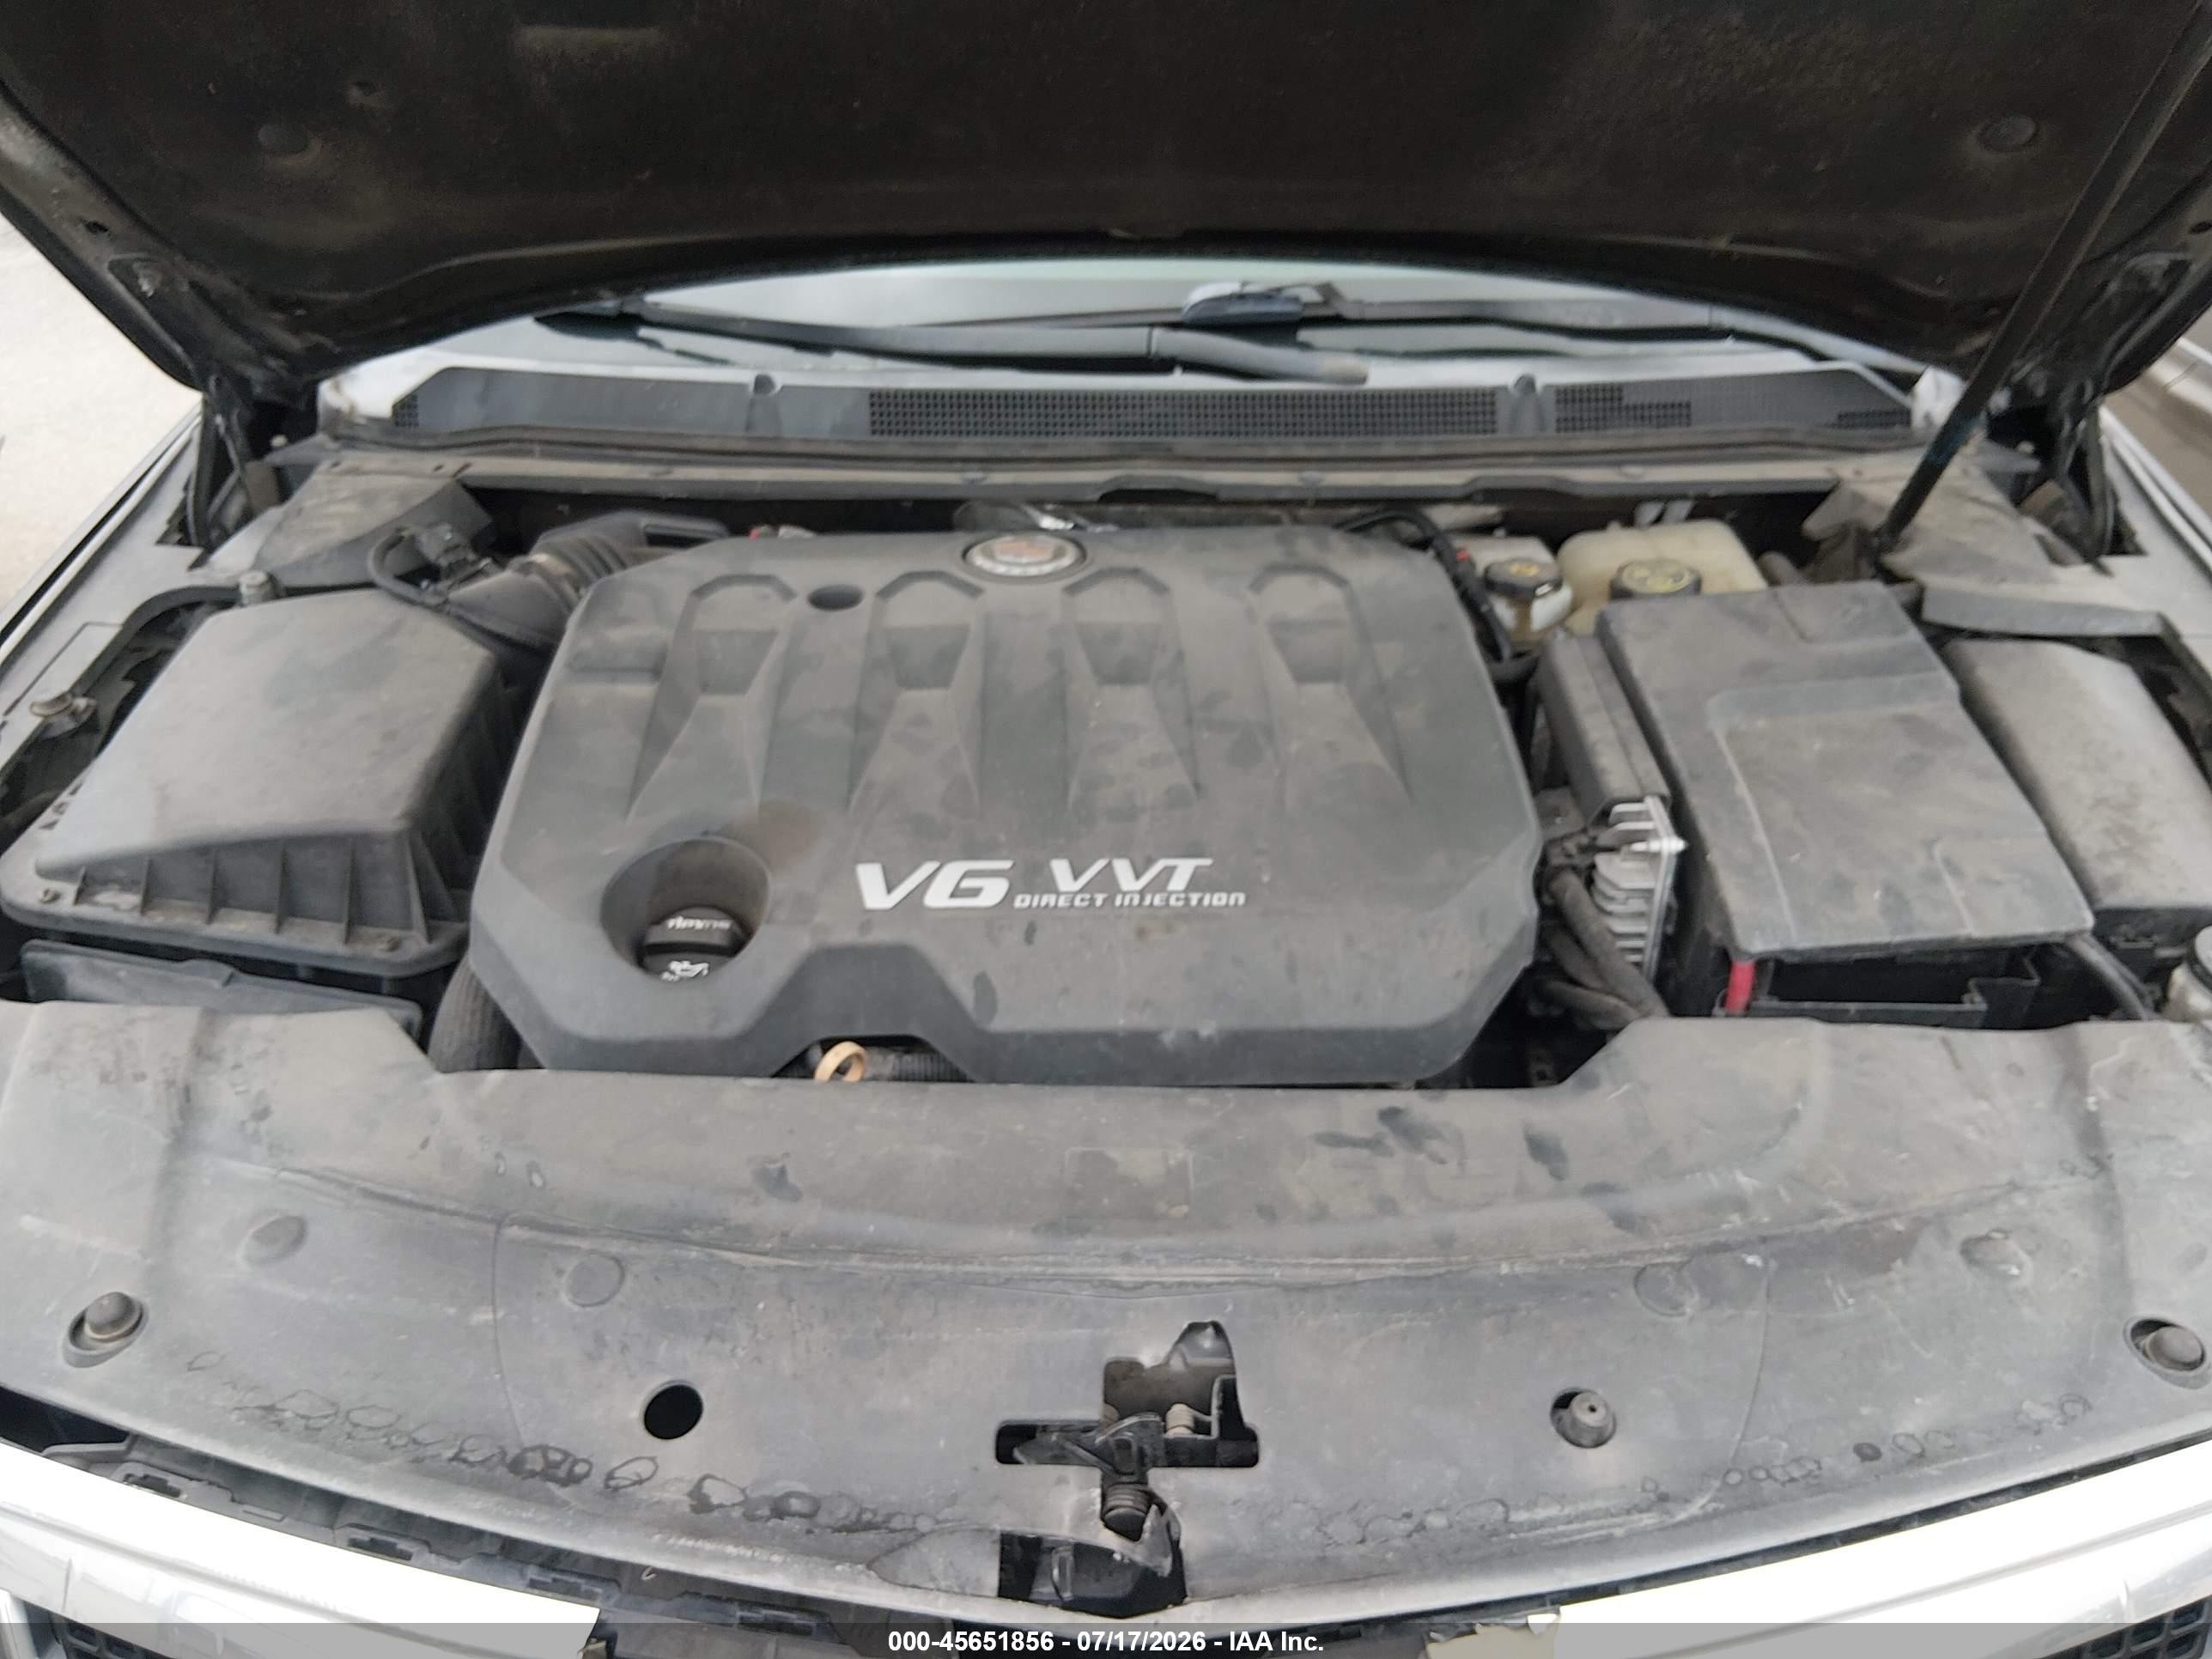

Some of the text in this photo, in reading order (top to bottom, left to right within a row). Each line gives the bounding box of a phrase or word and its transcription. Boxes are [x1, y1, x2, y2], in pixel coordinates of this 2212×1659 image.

[856, 858, 1213, 910] V6 VVT
[1013, 892, 1246, 908] DIRECT INJECTION
